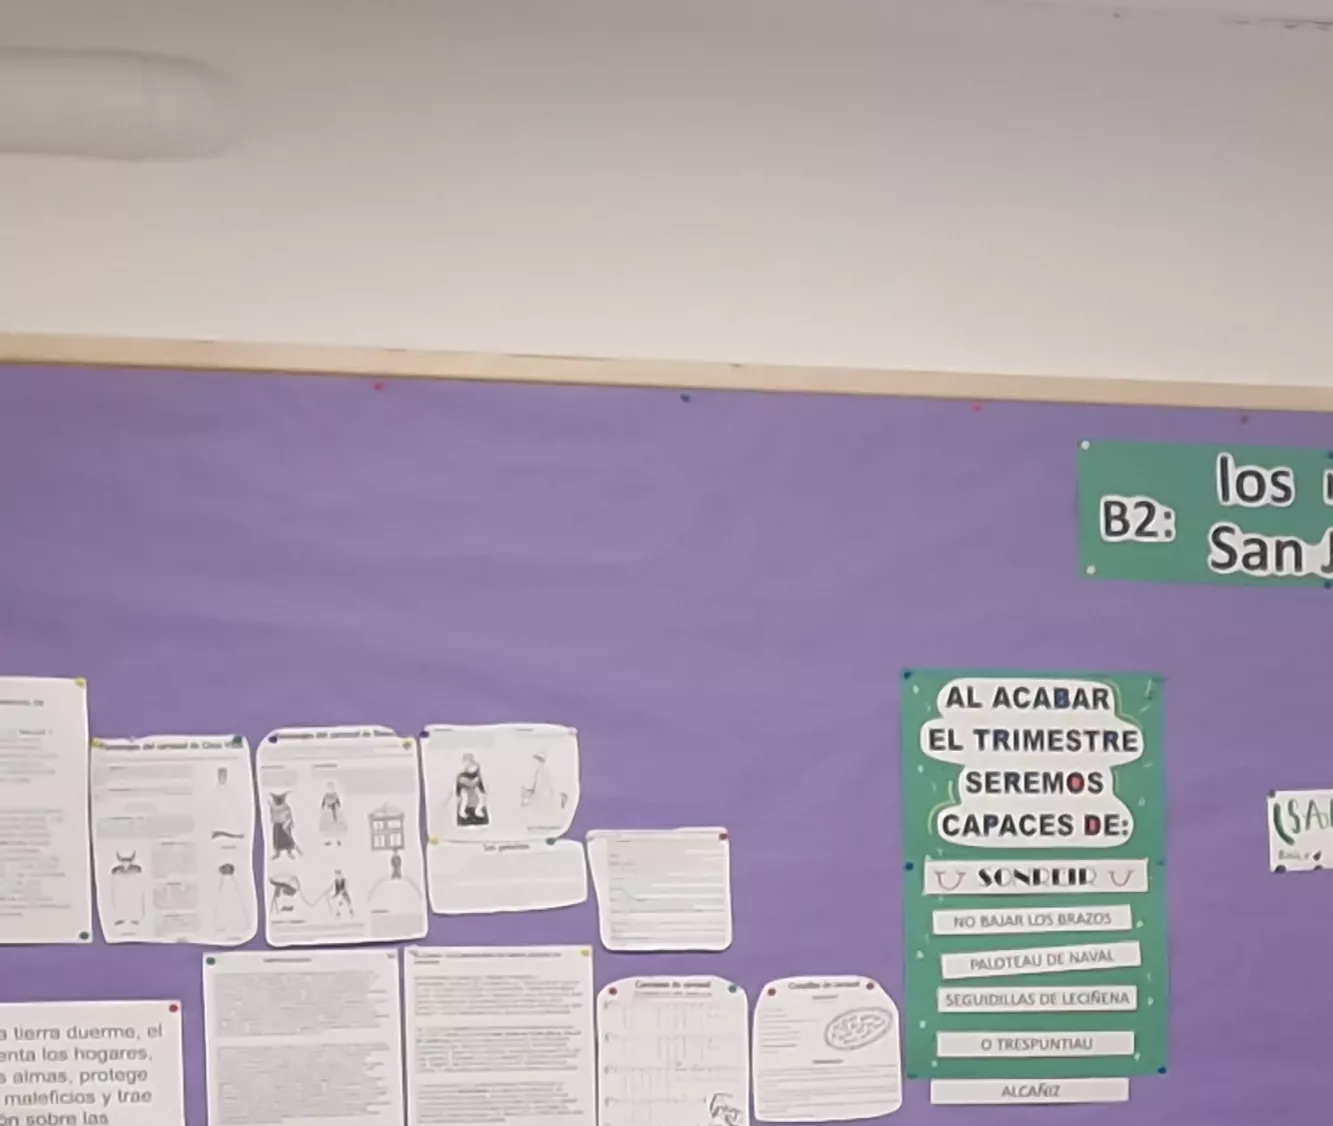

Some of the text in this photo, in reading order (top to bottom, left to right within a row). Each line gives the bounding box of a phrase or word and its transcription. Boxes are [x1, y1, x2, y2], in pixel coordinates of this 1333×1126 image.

[1219, 455, 1293, 504] los
[1103, 500, 1174, 538] B2:
[1210, 525, 1301, 572] San
[945, 686, 1110, 710] AL ACABAR
[928, 728, 1139, 752] EL TRIMESTRE
[965, 771, 1104, 794] SEREMOS
[942, 814, 1130, 837] CAPACES DE:
[953, 912, 1112, 929] NO BAJAR LOS BRAZOS
[970, 949, 1115, 971] PALOTEAU DE NAVAL
[945, 992, 1036, 1007] SEGUIDILLAS
[1039, 992, 1057, 1005] DE
[14, 1026, 61, 1040] tierra
[66, 1024, 141, 1040] duerme,
[147, 1023, 163, 1038] el
[997, 1037, 1093, 1051] TRESPUNTIAU
[42, 1047, 68, 1062] los
[74, 1047, 152, 1064] hogares,
[13, 1070, 73, 1084] almas,
[79, 1068, 148, 1085] protege
[4, 1089, 152, 1107] maleficios y trae
[1001, 1082, 1061, 1098] ALCAÑIZ
[26, 1113, 77, 1126] sobre
[83, 1111, 109, 1125] las
